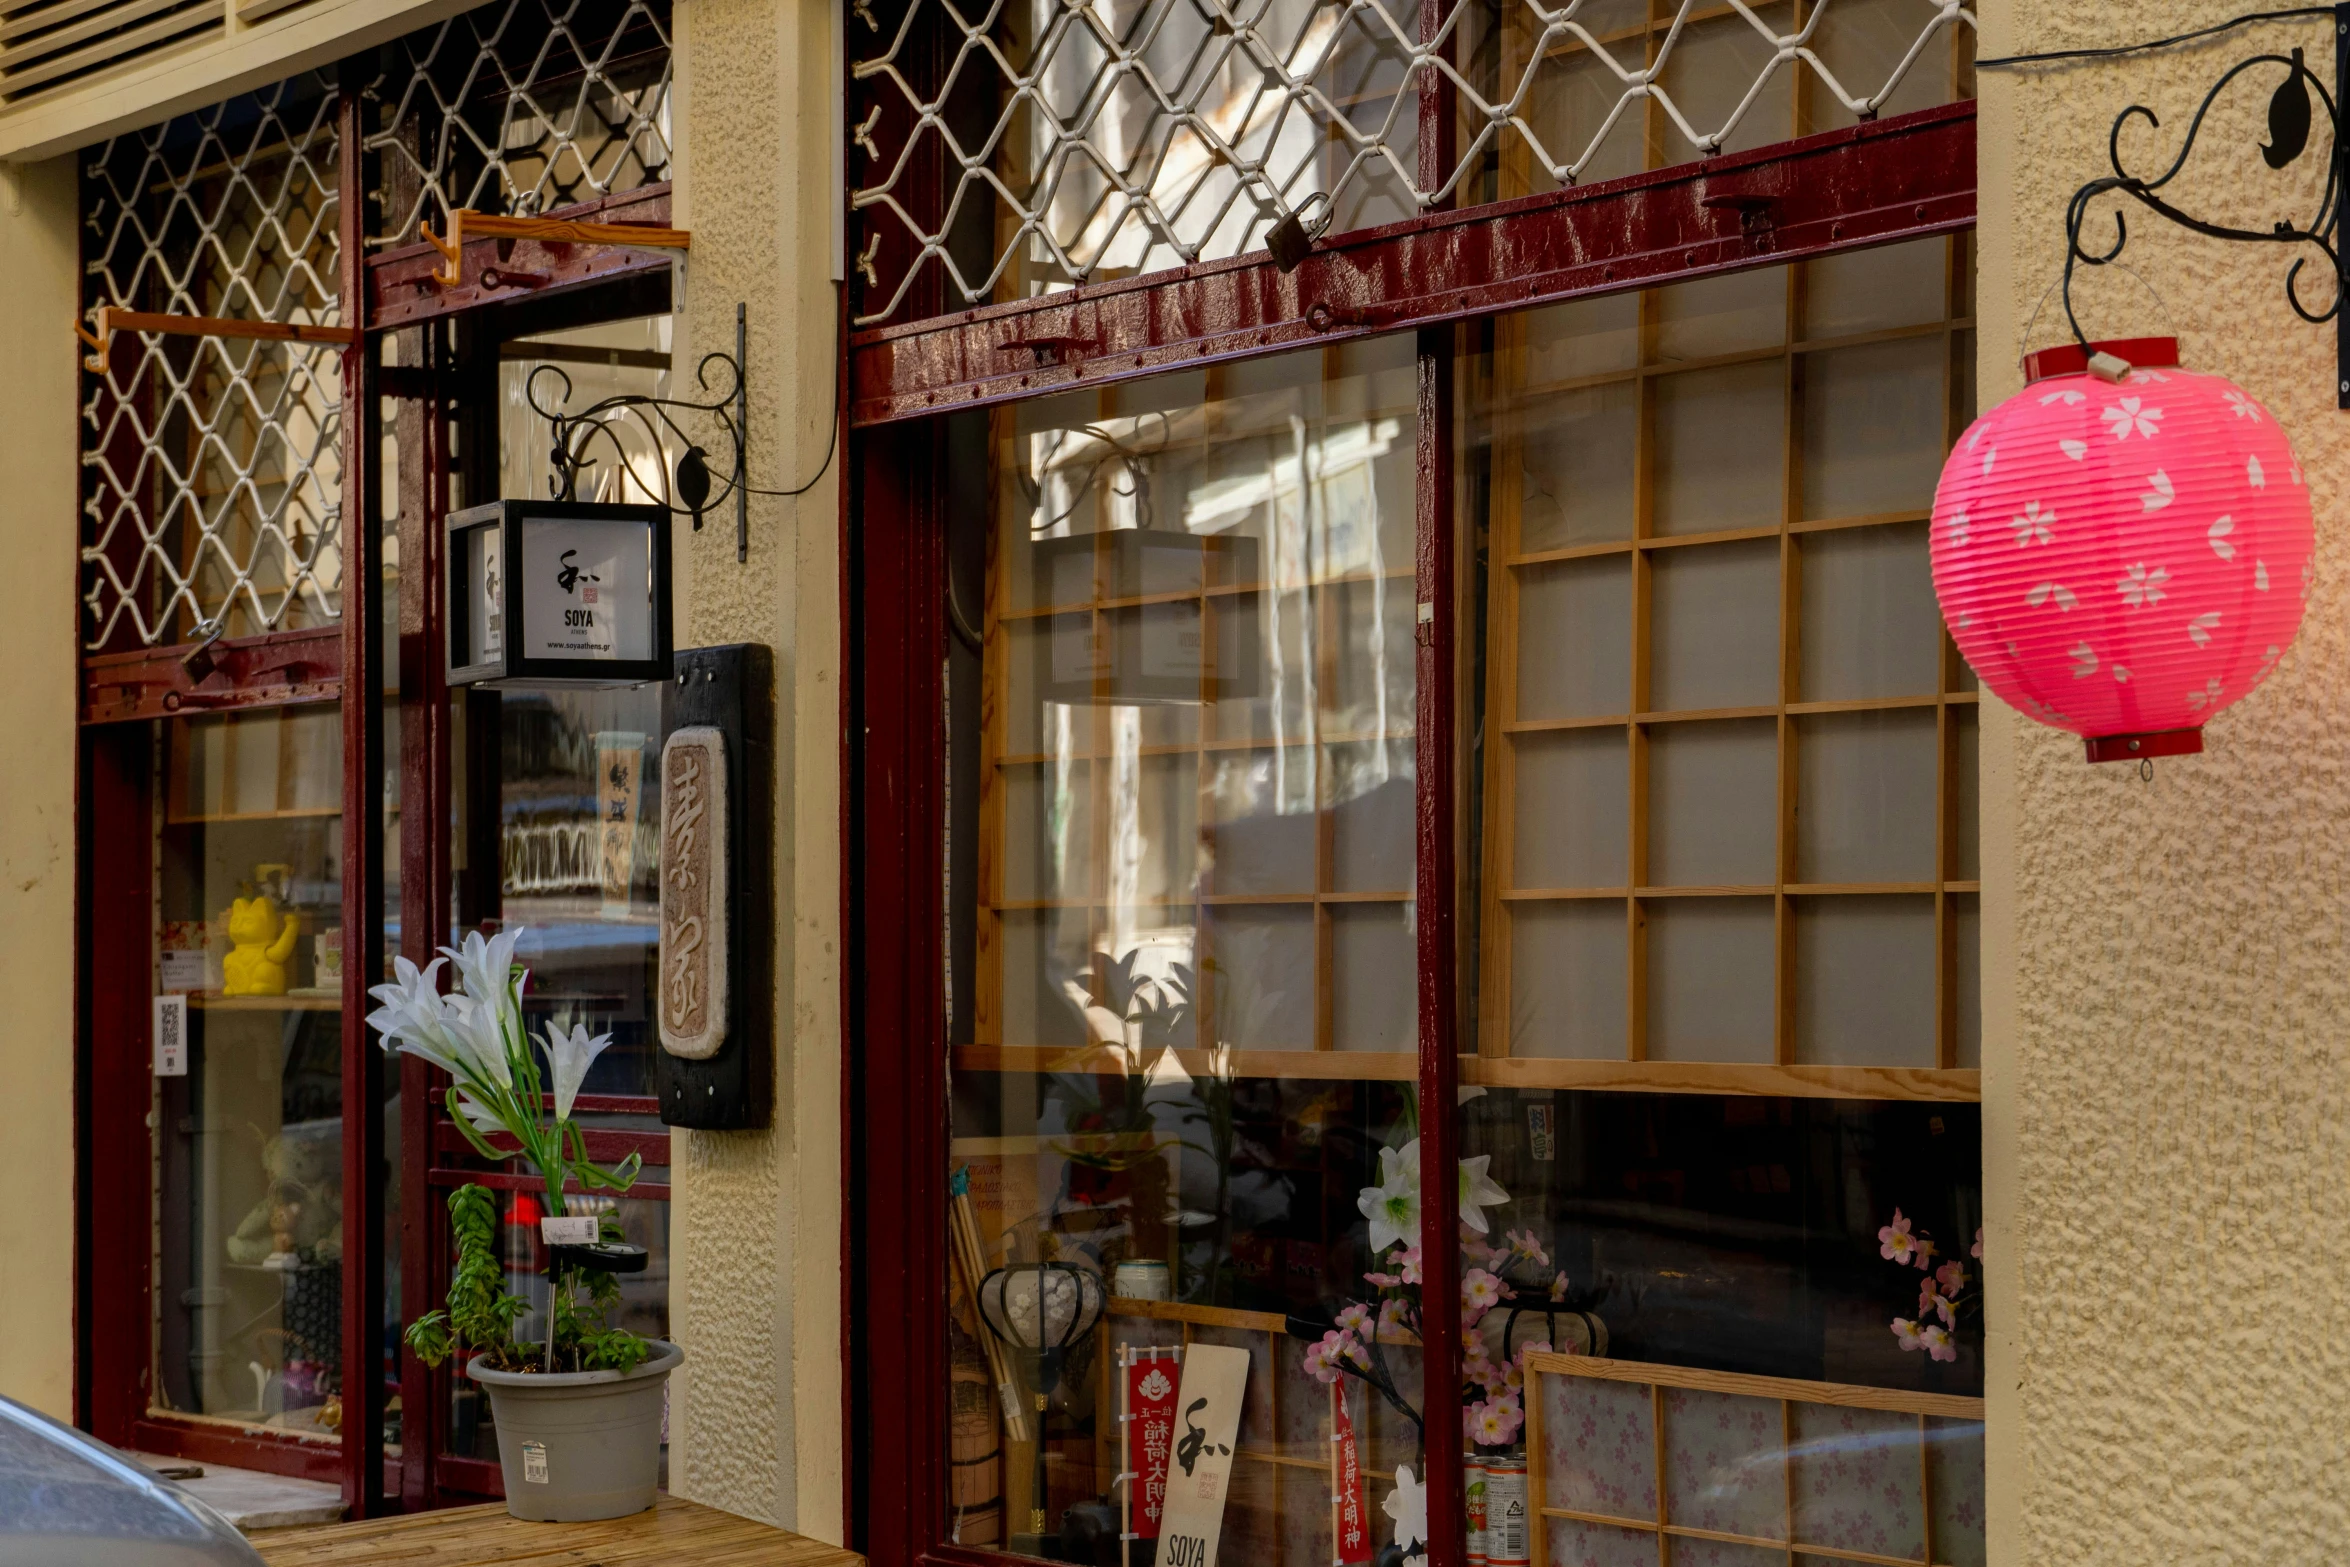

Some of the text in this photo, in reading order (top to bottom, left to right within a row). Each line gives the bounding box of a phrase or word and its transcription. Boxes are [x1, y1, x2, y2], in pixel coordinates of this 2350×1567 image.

[564, 609, 594, 628] SOYA
[547, 642, 611, 652] www.soyaathens.gr
[1167, 1534, 1206, 1567] SOYA
